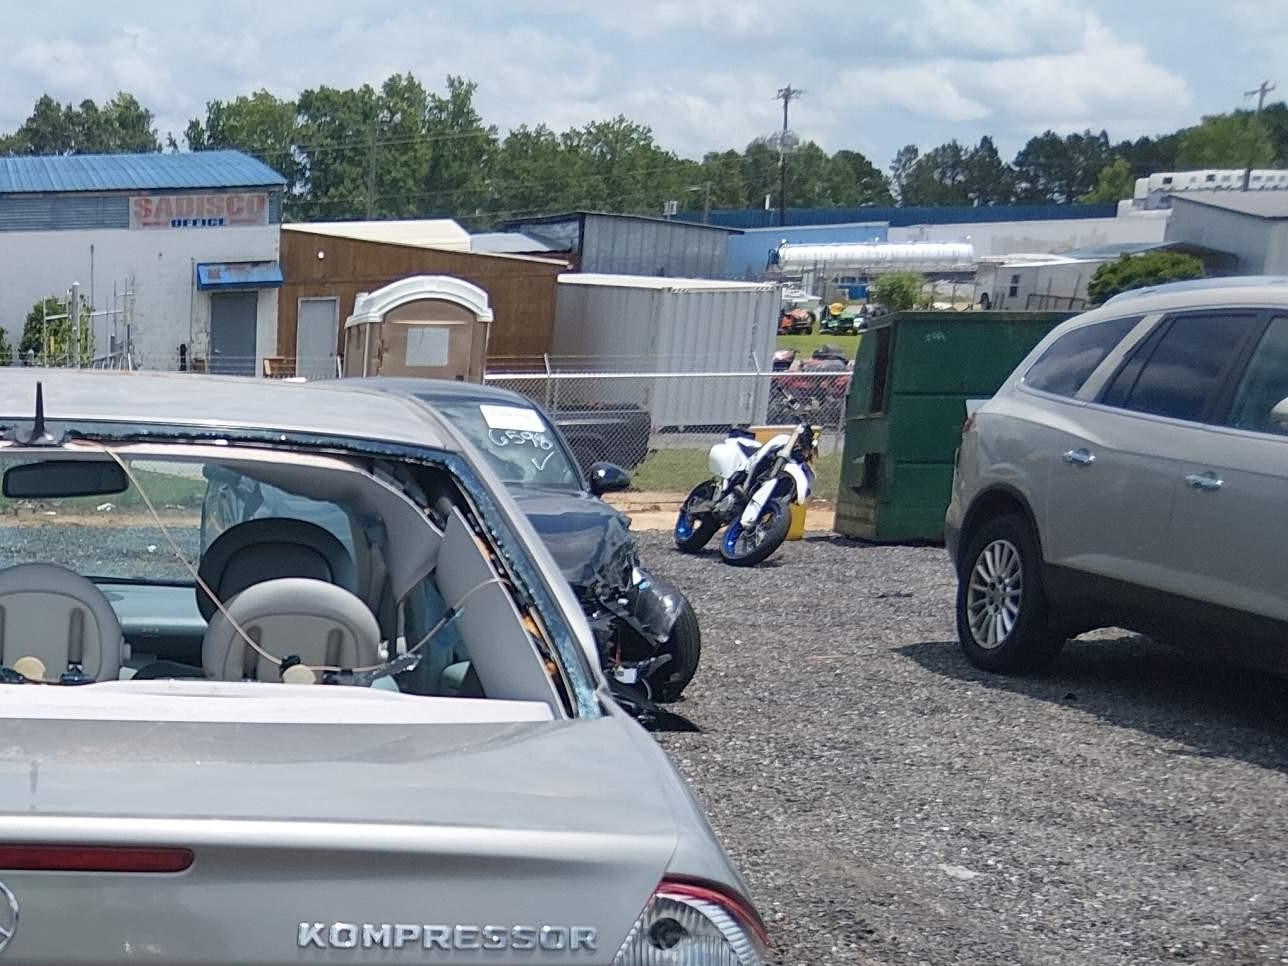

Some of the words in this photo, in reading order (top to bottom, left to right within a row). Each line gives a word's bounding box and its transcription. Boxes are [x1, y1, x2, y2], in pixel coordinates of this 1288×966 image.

[134, 194, 265, 219] SADISCO
[171, 217, 226, 228] OFFICE
[298, 921, 599, 950] KOMPRESSOR
